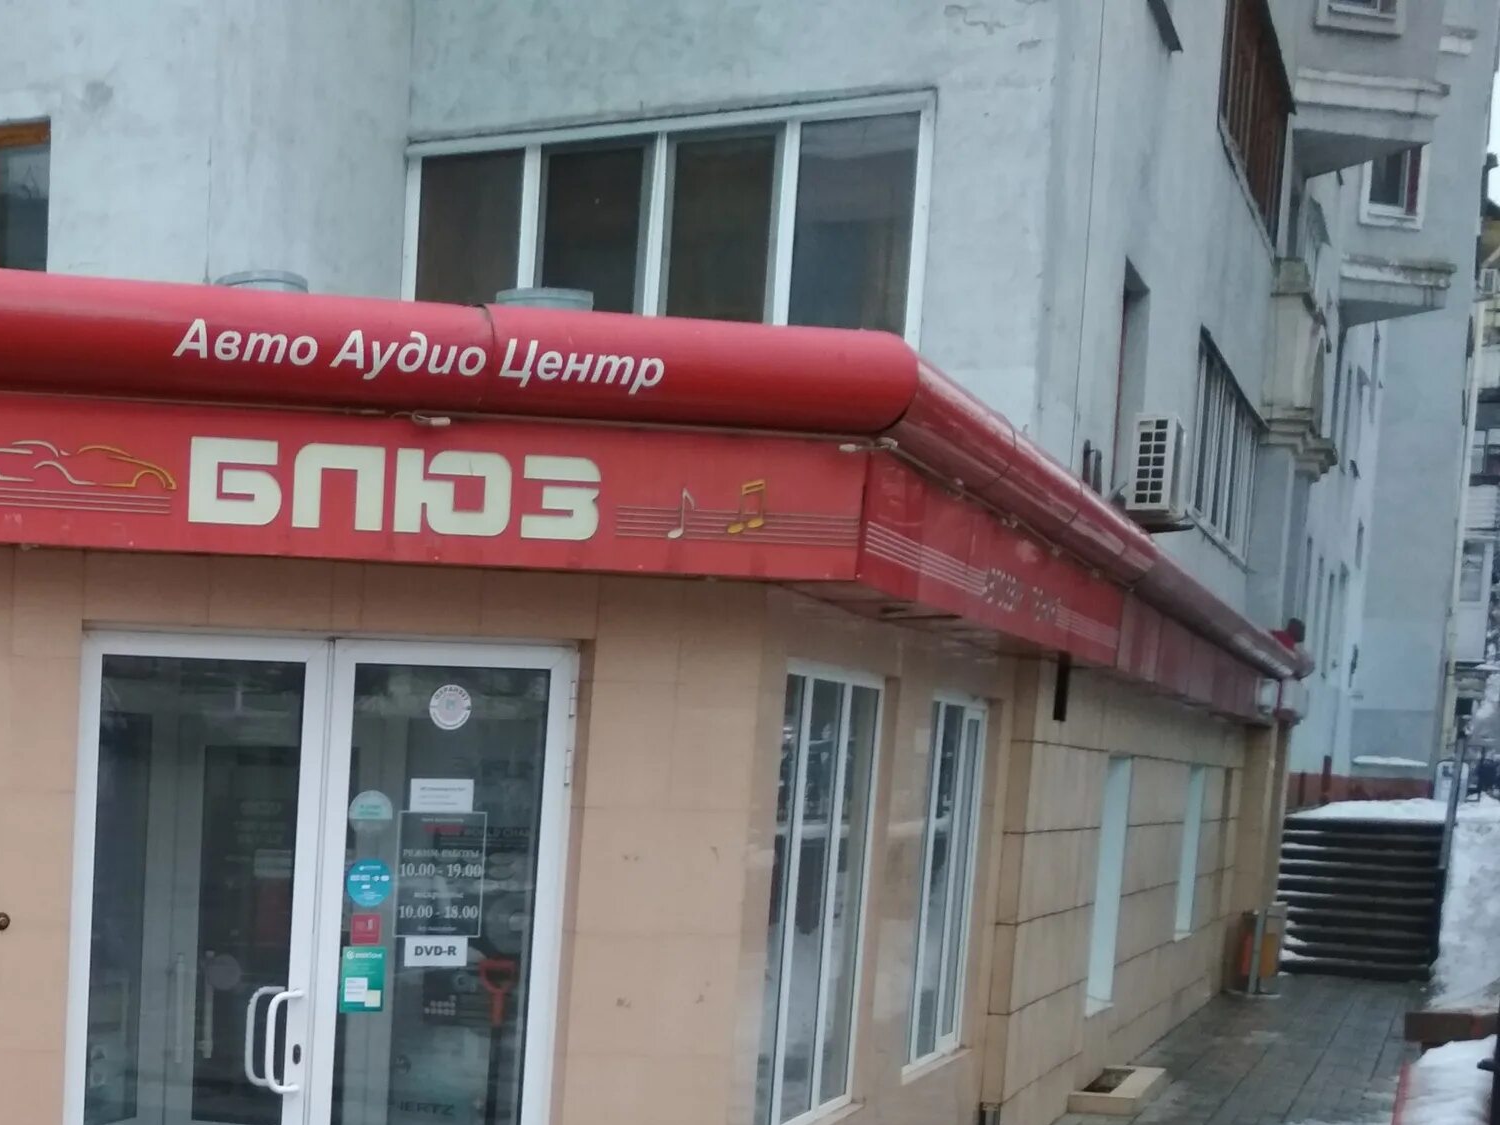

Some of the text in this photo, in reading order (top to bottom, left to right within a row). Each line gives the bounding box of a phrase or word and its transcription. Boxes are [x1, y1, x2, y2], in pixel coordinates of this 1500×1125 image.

[174, 318, 665, 395] Авто Аудио Центр
[187, 436, 601, 541] БЛЮЗ
[400, 863, 436, 878] 10.00
[446, 863, 482, 878] 19.00
[399, 905, 434, 919] 10.00
[443, 905, 479, 919] 18.00
[414, 945, 457, 956] DVD-R
